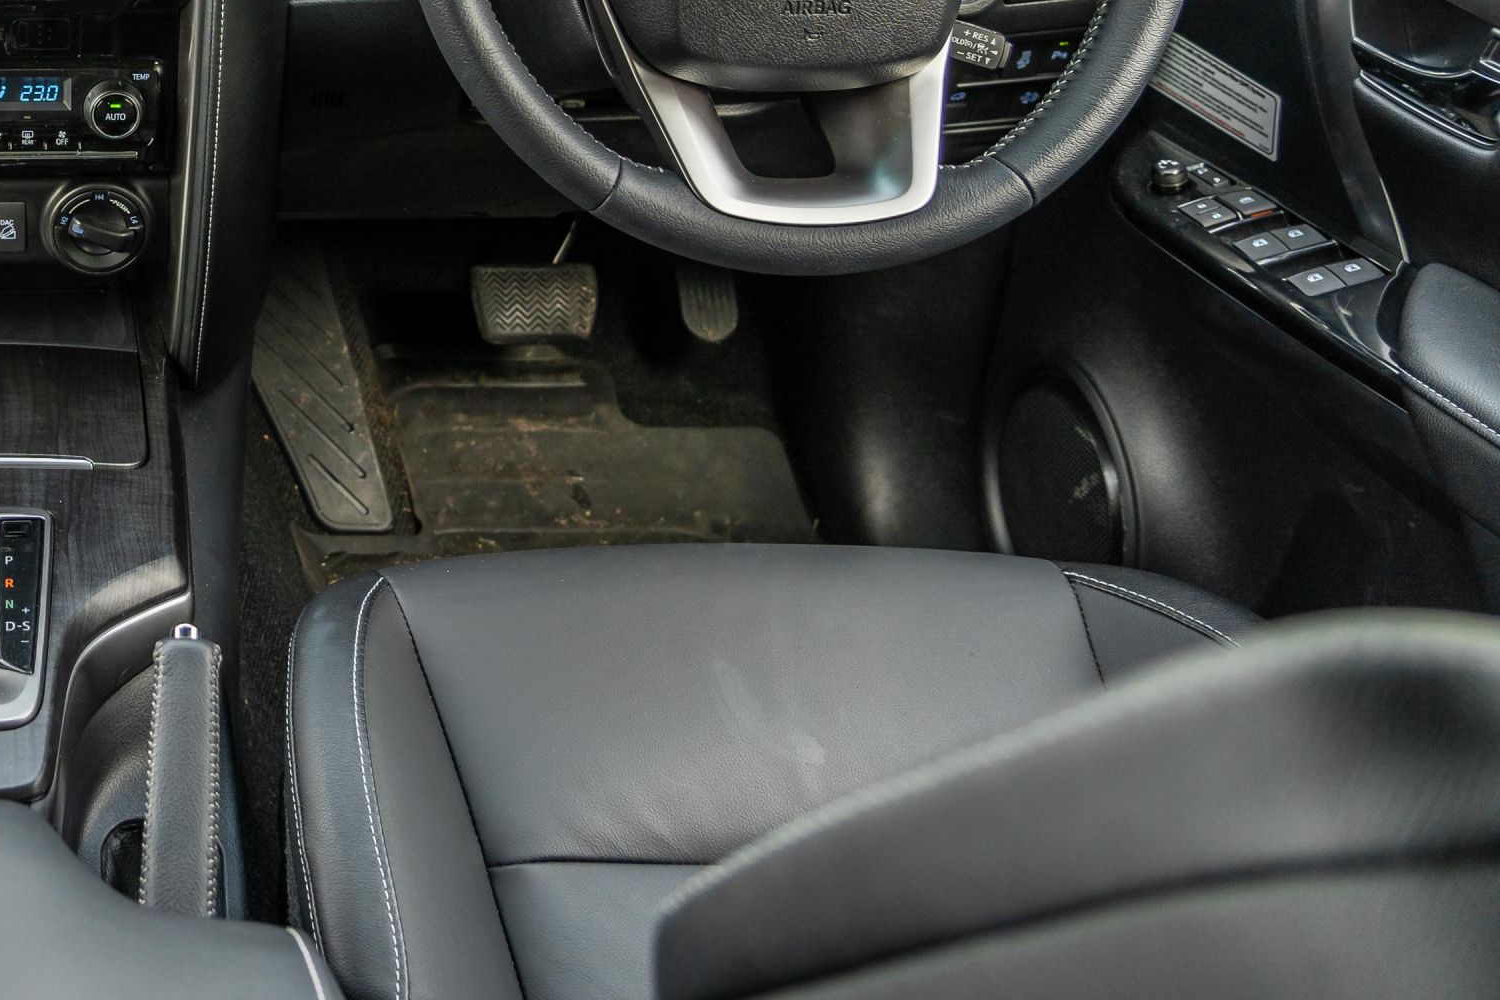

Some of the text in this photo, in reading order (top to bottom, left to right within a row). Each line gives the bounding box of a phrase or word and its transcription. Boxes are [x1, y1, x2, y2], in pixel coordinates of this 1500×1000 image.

[782, 0, 852, 15] AIRBAG
[972, 31, 989, 43] RES
[965, 51, 983, 63] SET
[132, 73, 150, 81] TEMP
[19, 85, 59, 102] 23.0
[105, 112, 126, 121] AUTO
[55, 138, 69, 146] OFF
[112, 200, 128, 212] PUSH
[60, 216, 69, 225] H2
[130, 215, 139, 224] L4
[5, 555, 14, 565] P
[4, 578, 14, 588] R
[5, 599, 14, 609] N
